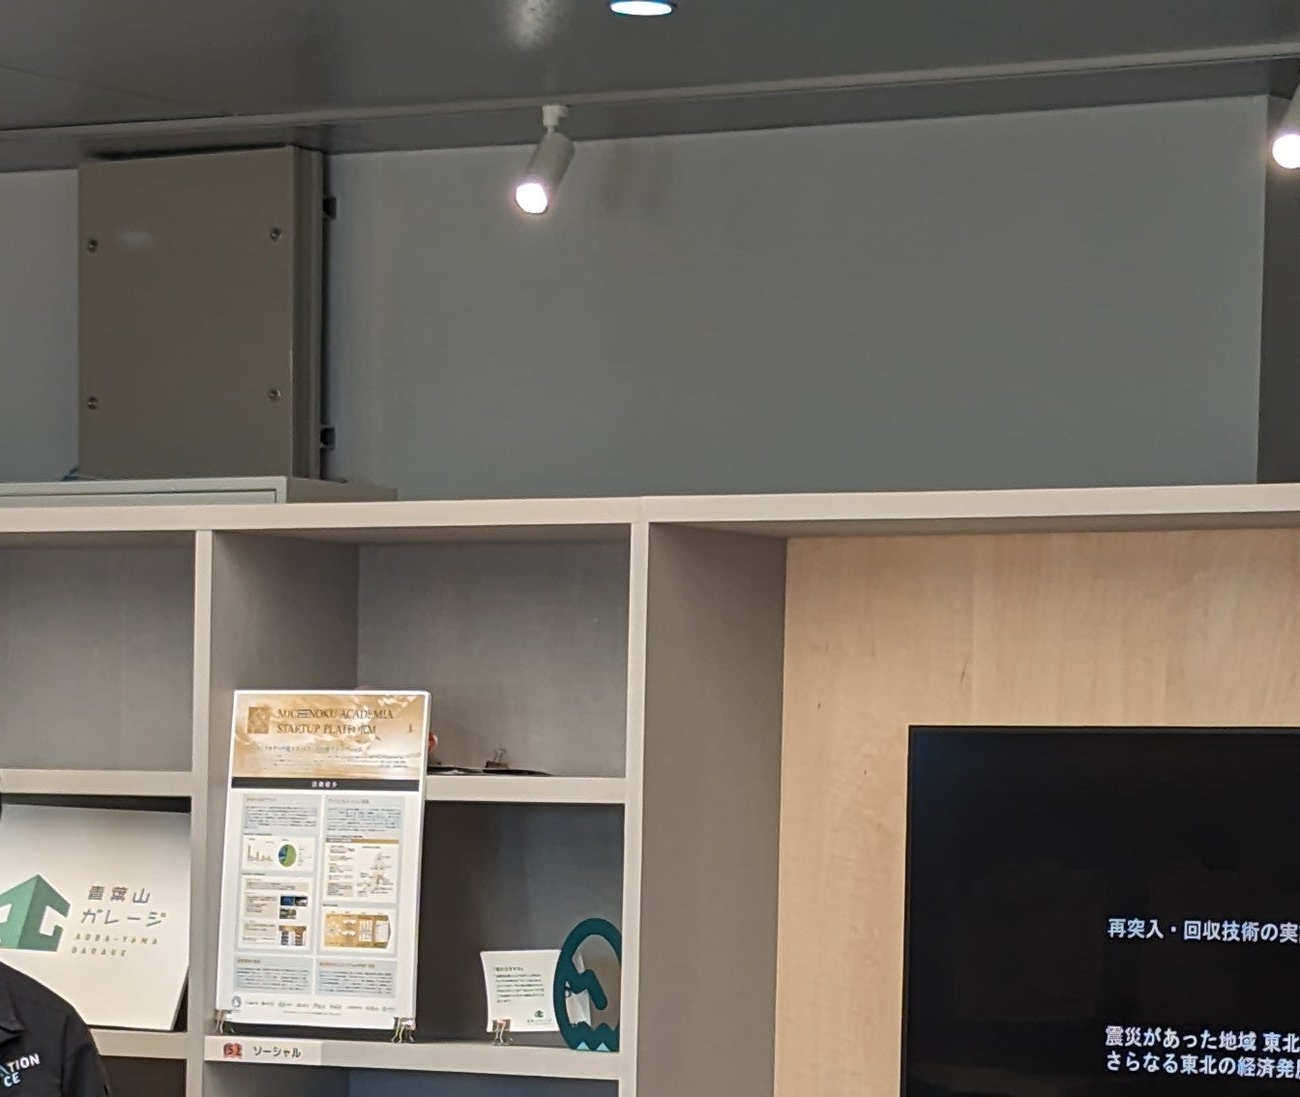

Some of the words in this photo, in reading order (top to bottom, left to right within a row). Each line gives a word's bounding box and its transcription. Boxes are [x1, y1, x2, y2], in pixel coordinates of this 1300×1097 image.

[341, 708, 394, 721] ACADEMIA
[277, 723, 321, 735] STARTUP
[80, 907, 167, 929] ガレージ
[1105, 1025, 1257, 1051] 震災があった地域
[252, 1046, 302, 1059] ソーシャル
